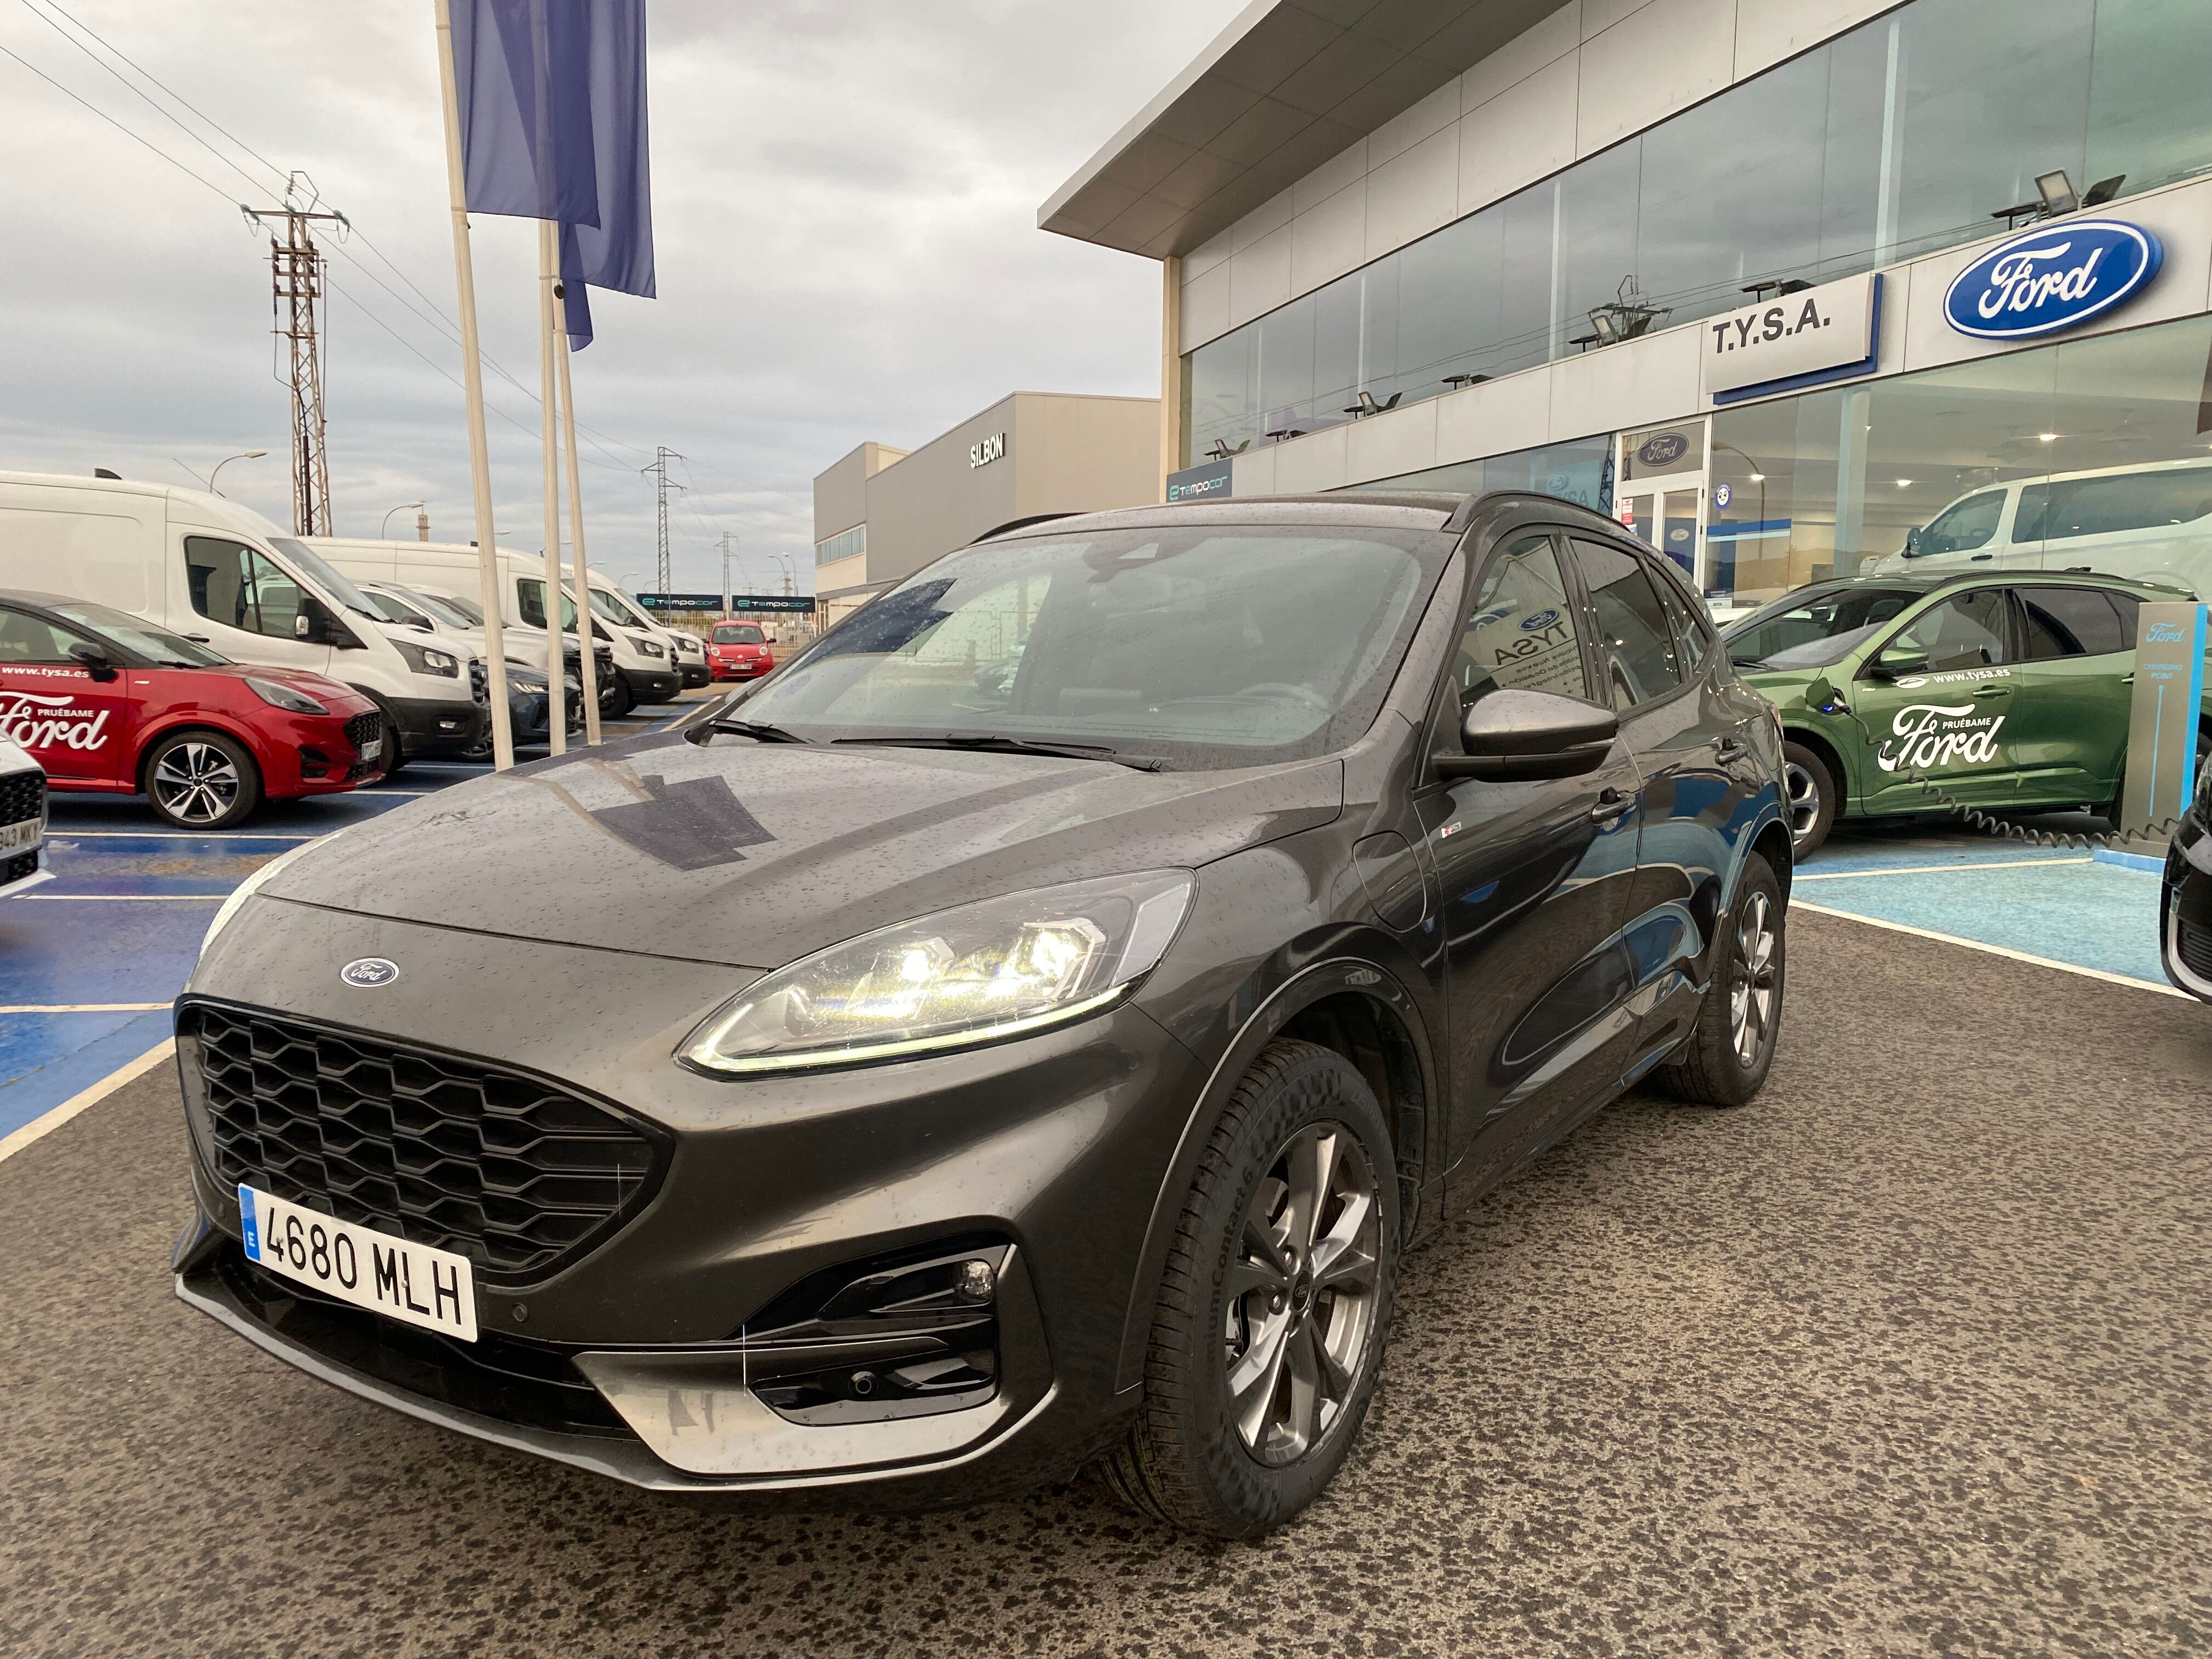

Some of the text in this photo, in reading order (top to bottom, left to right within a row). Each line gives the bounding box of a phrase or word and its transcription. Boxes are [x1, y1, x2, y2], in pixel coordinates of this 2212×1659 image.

[1978, 241, 2103, 319] Ford
[1713, 298, 1830, 353] T.Y.S.A.
[970, 432, 1003, 469] SILBON
[1647, 438, 1678, 460] Ford
[2145, 623, 2186, 642] Ford
[2, 667, 90, 678] www.tysa.es
[1933, 668, 2011, 683] www.tysa.es
[37, 708, 94, 718] PRUÉBAME
[1942, 717, 1991, 730] PRUÉBAME
[1878, 703, 2006, 771] Ford
[351, 963, 387, 981] Ford
[248, 1231, 255, 1247] E
[267, 1207, 461, 1325] 4680 MLH
